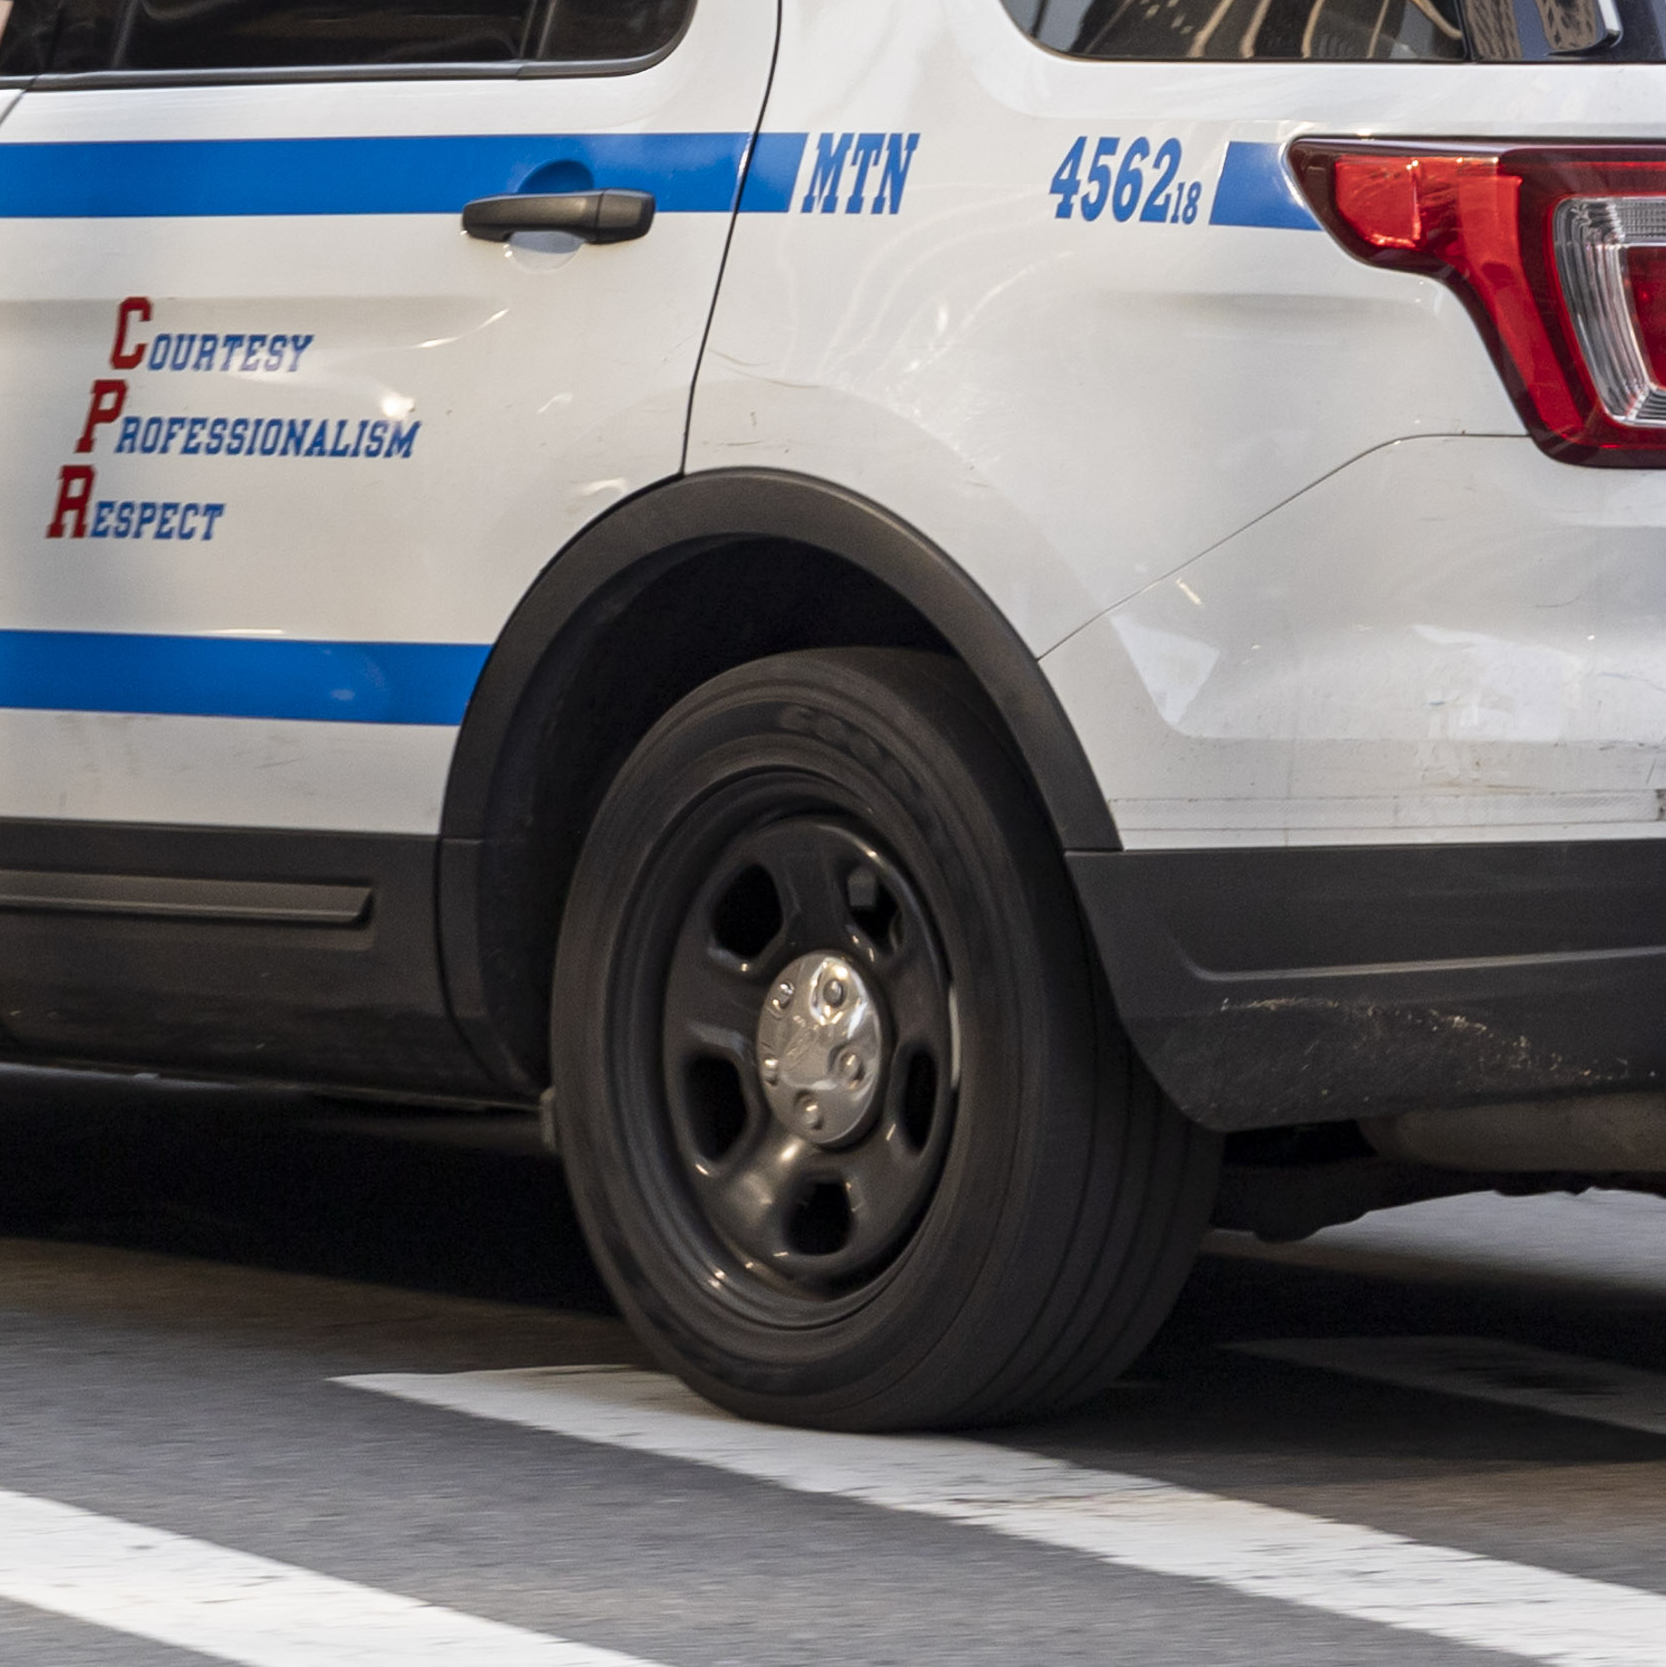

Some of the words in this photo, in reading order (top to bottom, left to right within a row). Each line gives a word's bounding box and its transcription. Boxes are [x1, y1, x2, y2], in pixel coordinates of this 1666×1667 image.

[801, 132, 921, 215] MTN
[110, 296, 315, 372] COURTESY
[73, 378, 423, 459] PROFESSIONALISM
[45, 463, 227, 541] RESPECT
